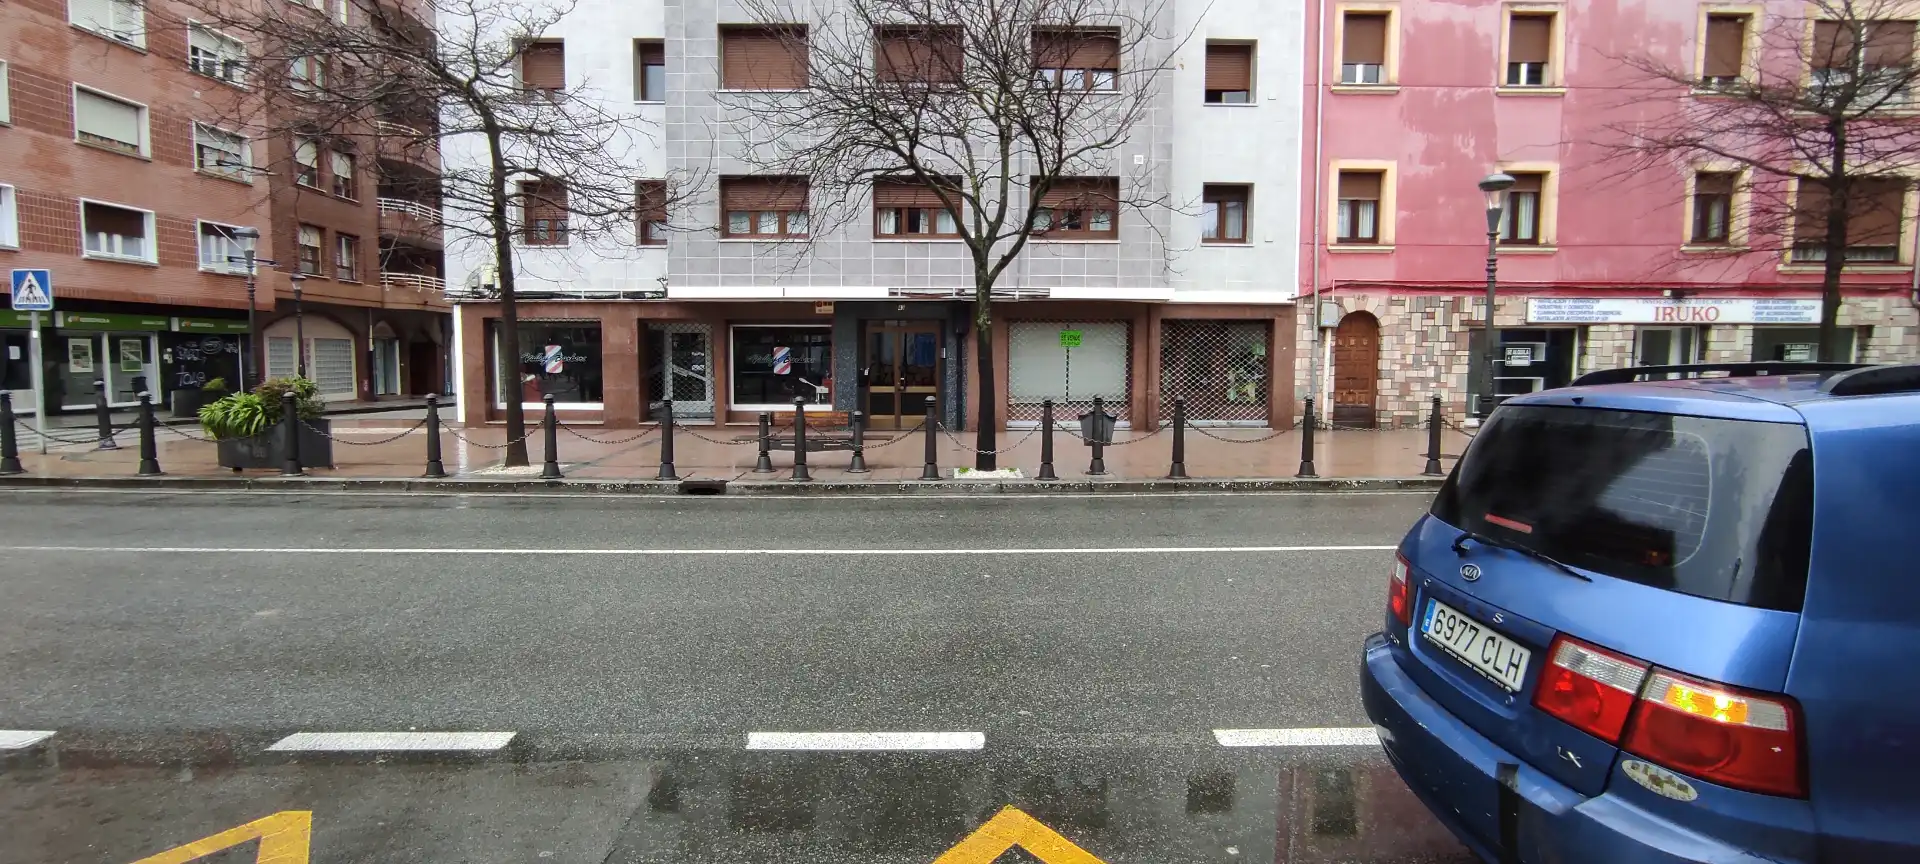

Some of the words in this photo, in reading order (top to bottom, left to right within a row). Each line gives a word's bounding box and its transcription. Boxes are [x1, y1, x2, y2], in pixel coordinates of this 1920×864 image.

[1654, 306, 1719, 321] IRUKO
[1462, 566, 1479, 579] KIA
[1434, 609, 1480, 653] 6977
[1481, 635, 1523, 683] CLH
[1557, 746, 1582, 768] LX
